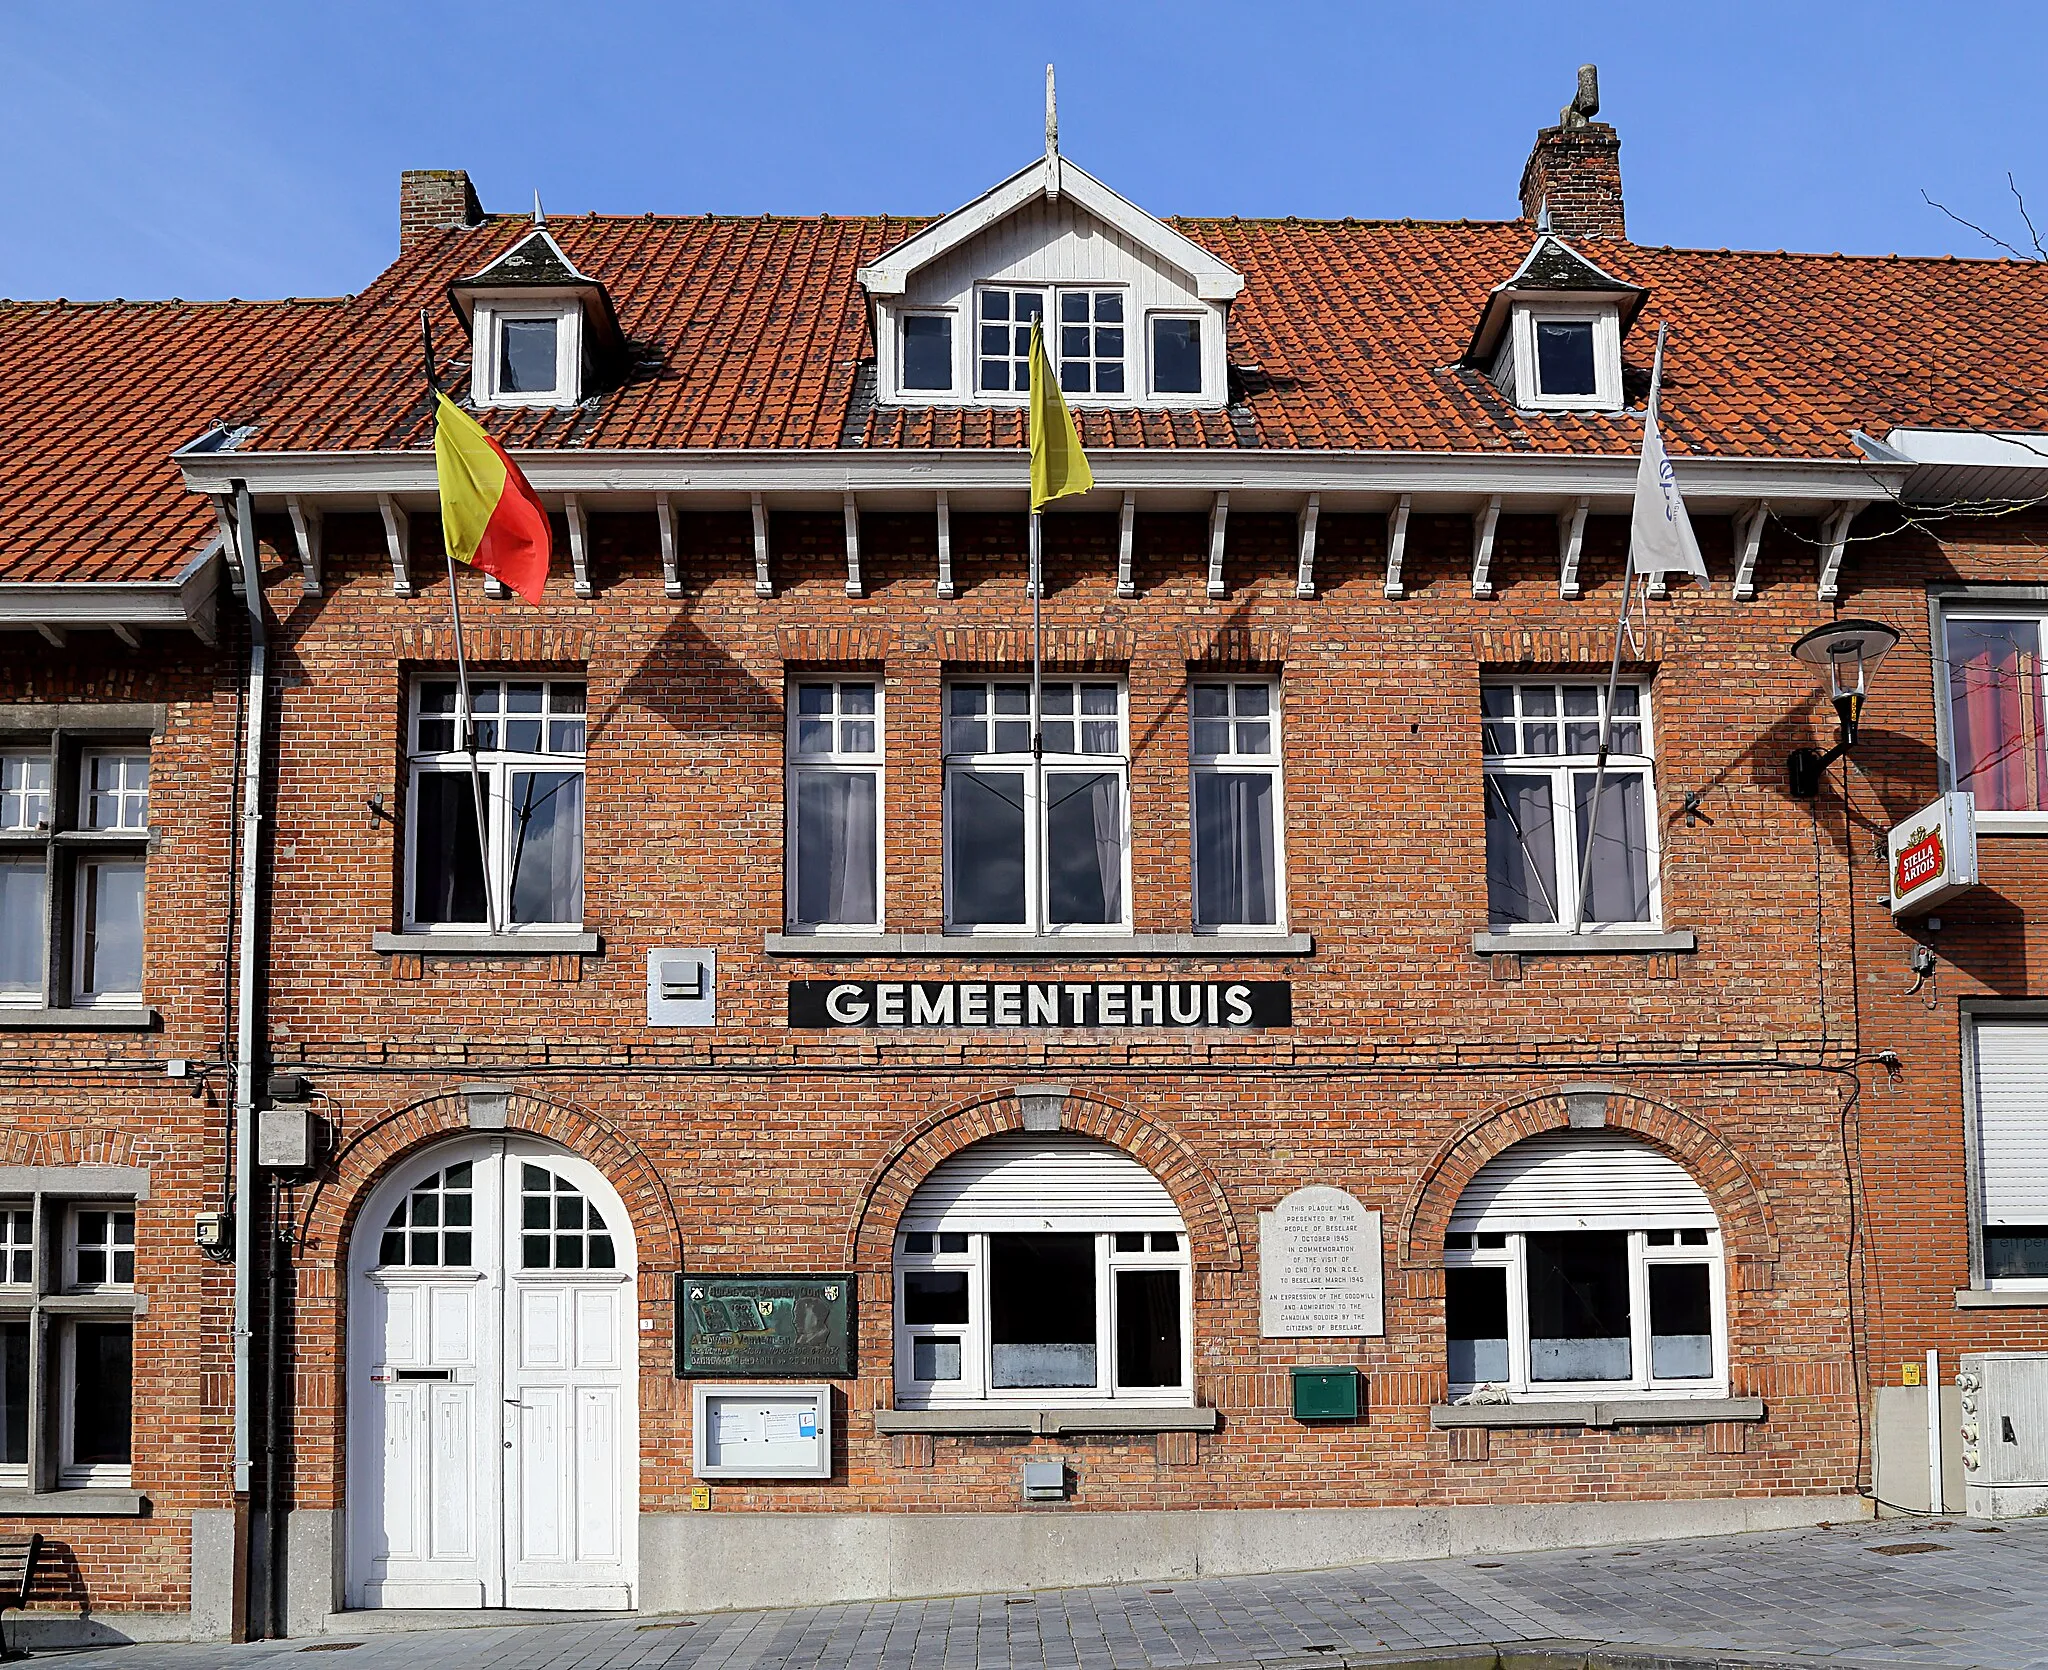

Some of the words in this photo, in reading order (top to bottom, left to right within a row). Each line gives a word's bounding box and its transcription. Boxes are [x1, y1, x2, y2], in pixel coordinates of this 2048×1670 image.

[1903, 845, 1934, 871] STELLA
[1904, 857, 1935, 884] ARTOIS
[825, 984, 1255, 1025] GEMEENTEHUIS
